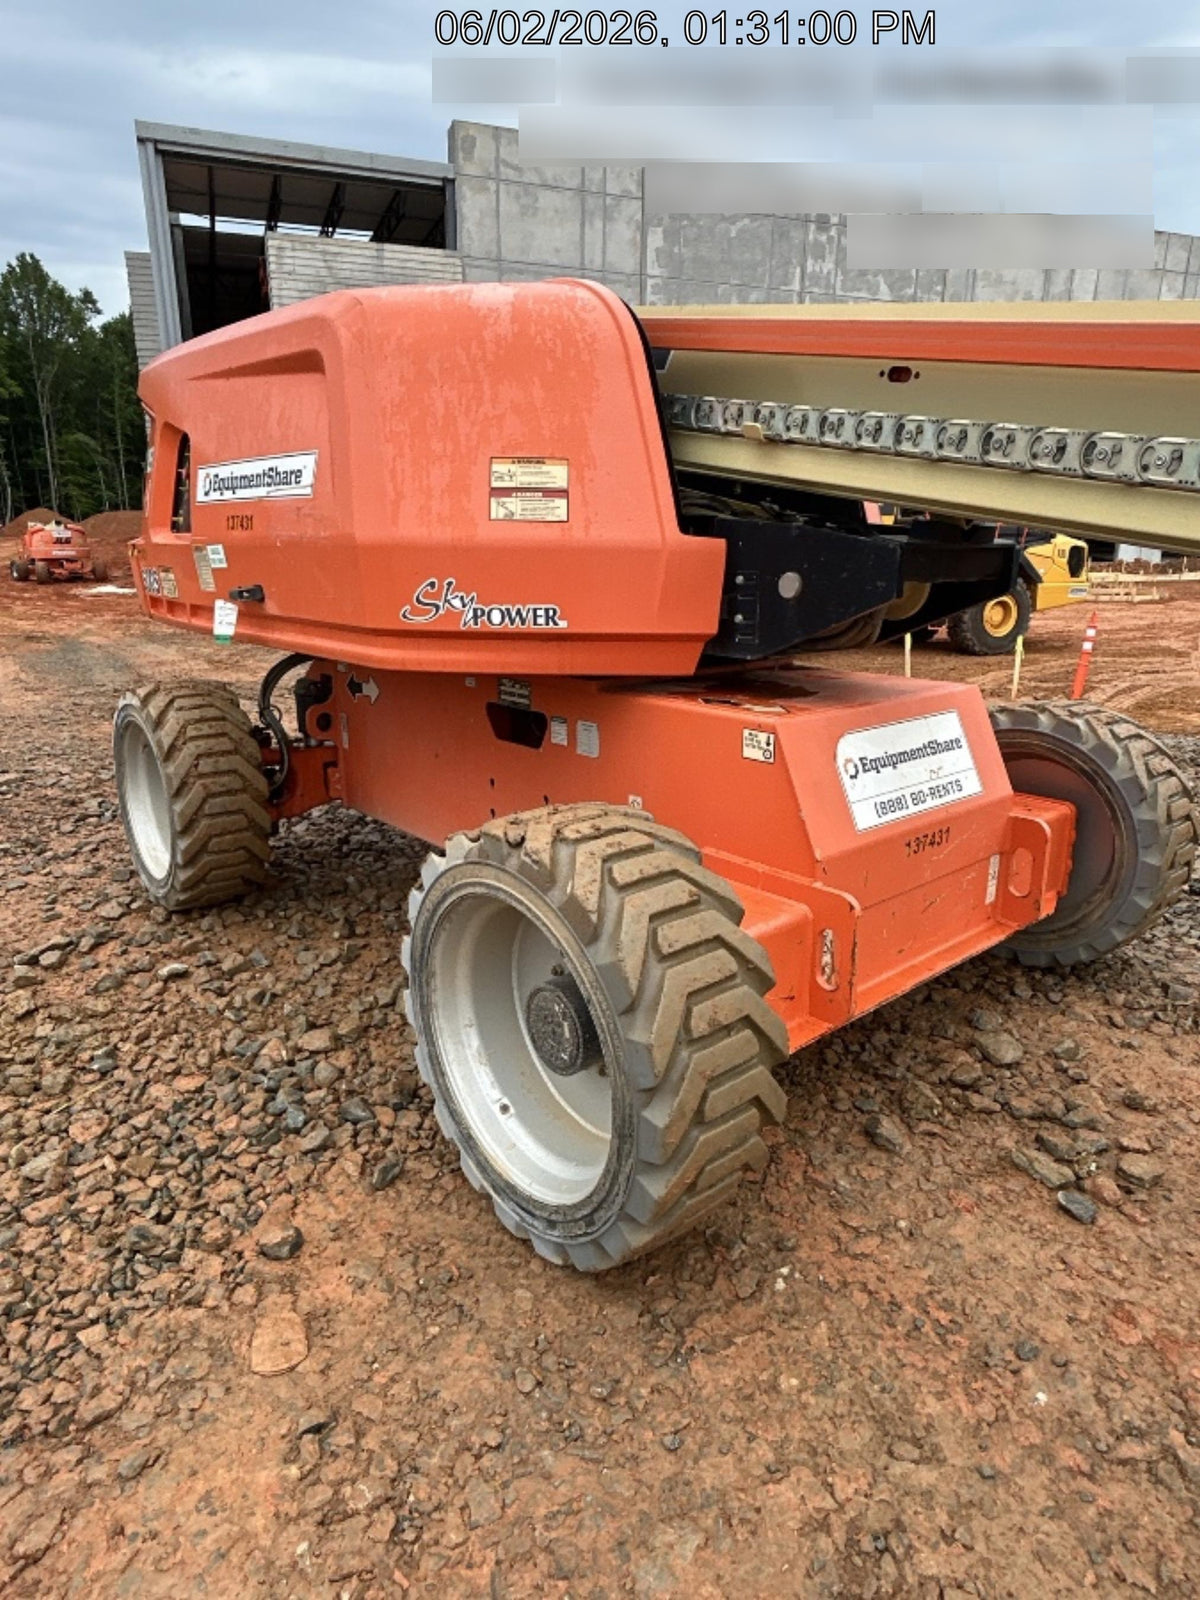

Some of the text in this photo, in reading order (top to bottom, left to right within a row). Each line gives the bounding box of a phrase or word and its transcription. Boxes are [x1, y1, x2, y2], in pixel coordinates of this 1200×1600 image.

[213, 466, 303, 496] EquipmentShare
[227, 514, 254, 531] 137431
[400, 578, 560, 628] Sky POWER
[859, 737, 963, 774] EquipmentShare
[905, 826, 951, 857] 137431
